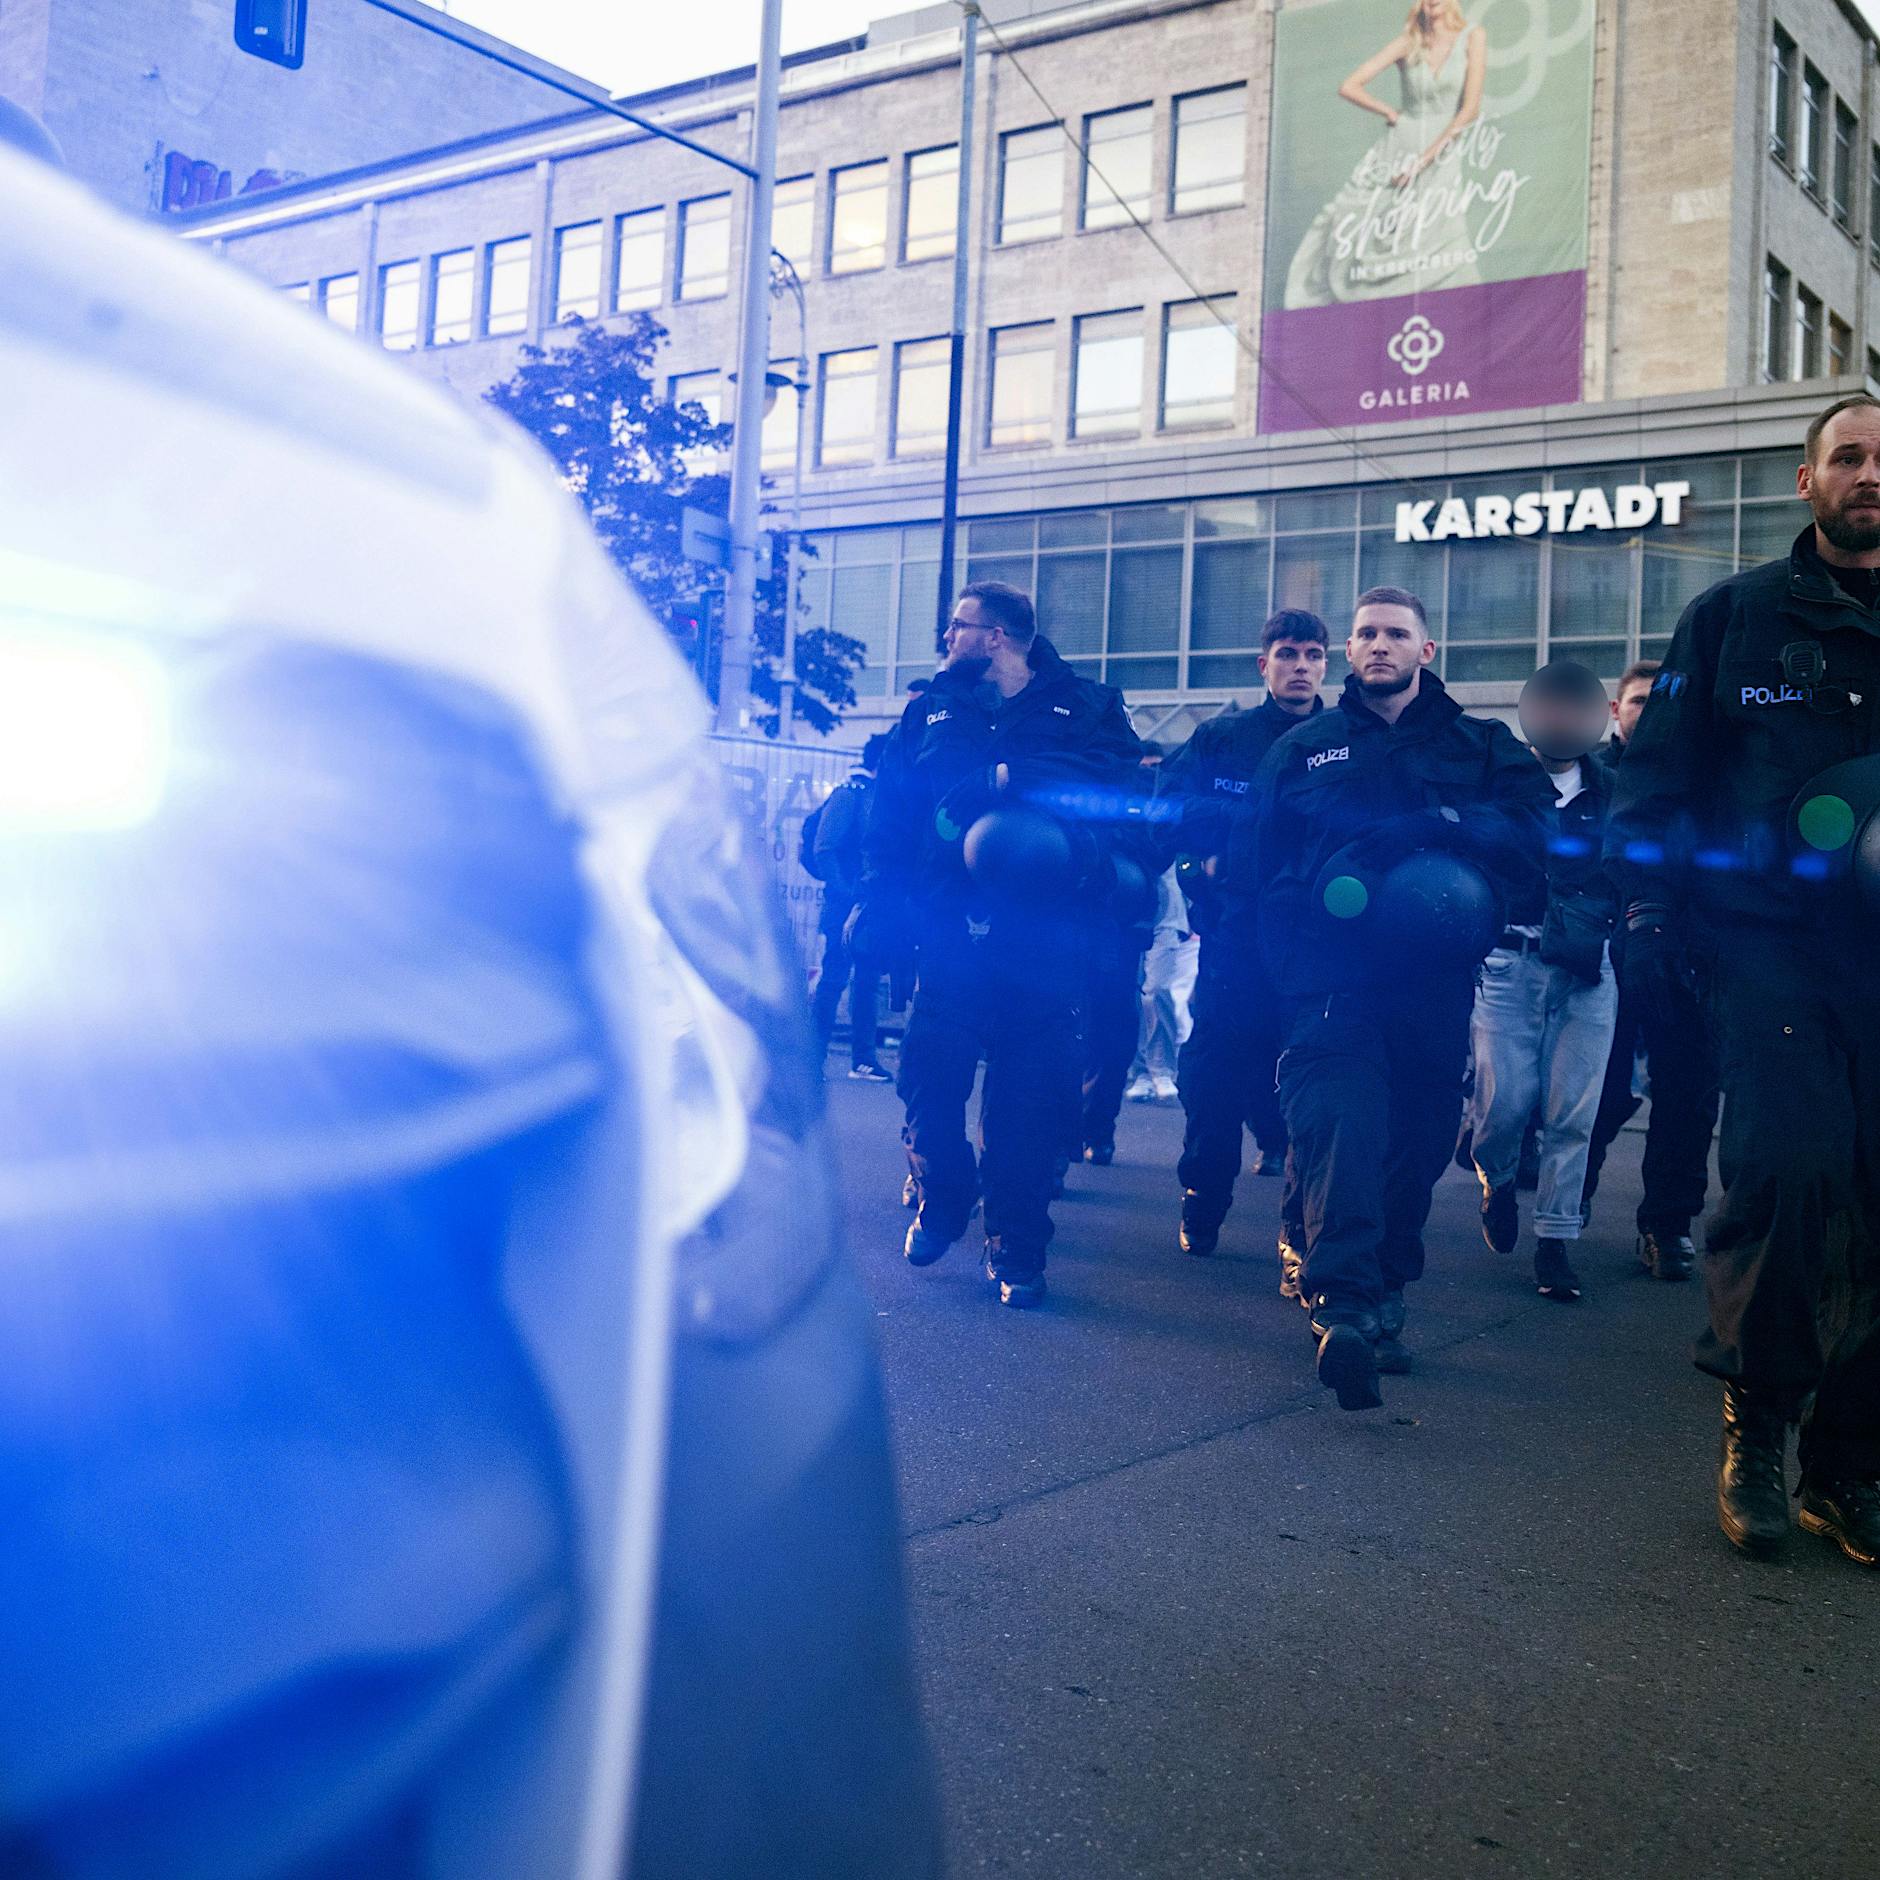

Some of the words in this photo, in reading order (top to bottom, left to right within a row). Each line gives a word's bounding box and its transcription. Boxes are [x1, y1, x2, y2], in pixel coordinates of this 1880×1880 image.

[1334, 169, 1531, 260] shopping
[1359, 381, 1470, 409] GALERIA
[1394, 481, 1690, 542] KARSTADT
[1306, 746, 1349, 772] POLIZEI
[1214, 777, 1250, 794] POLIZ
